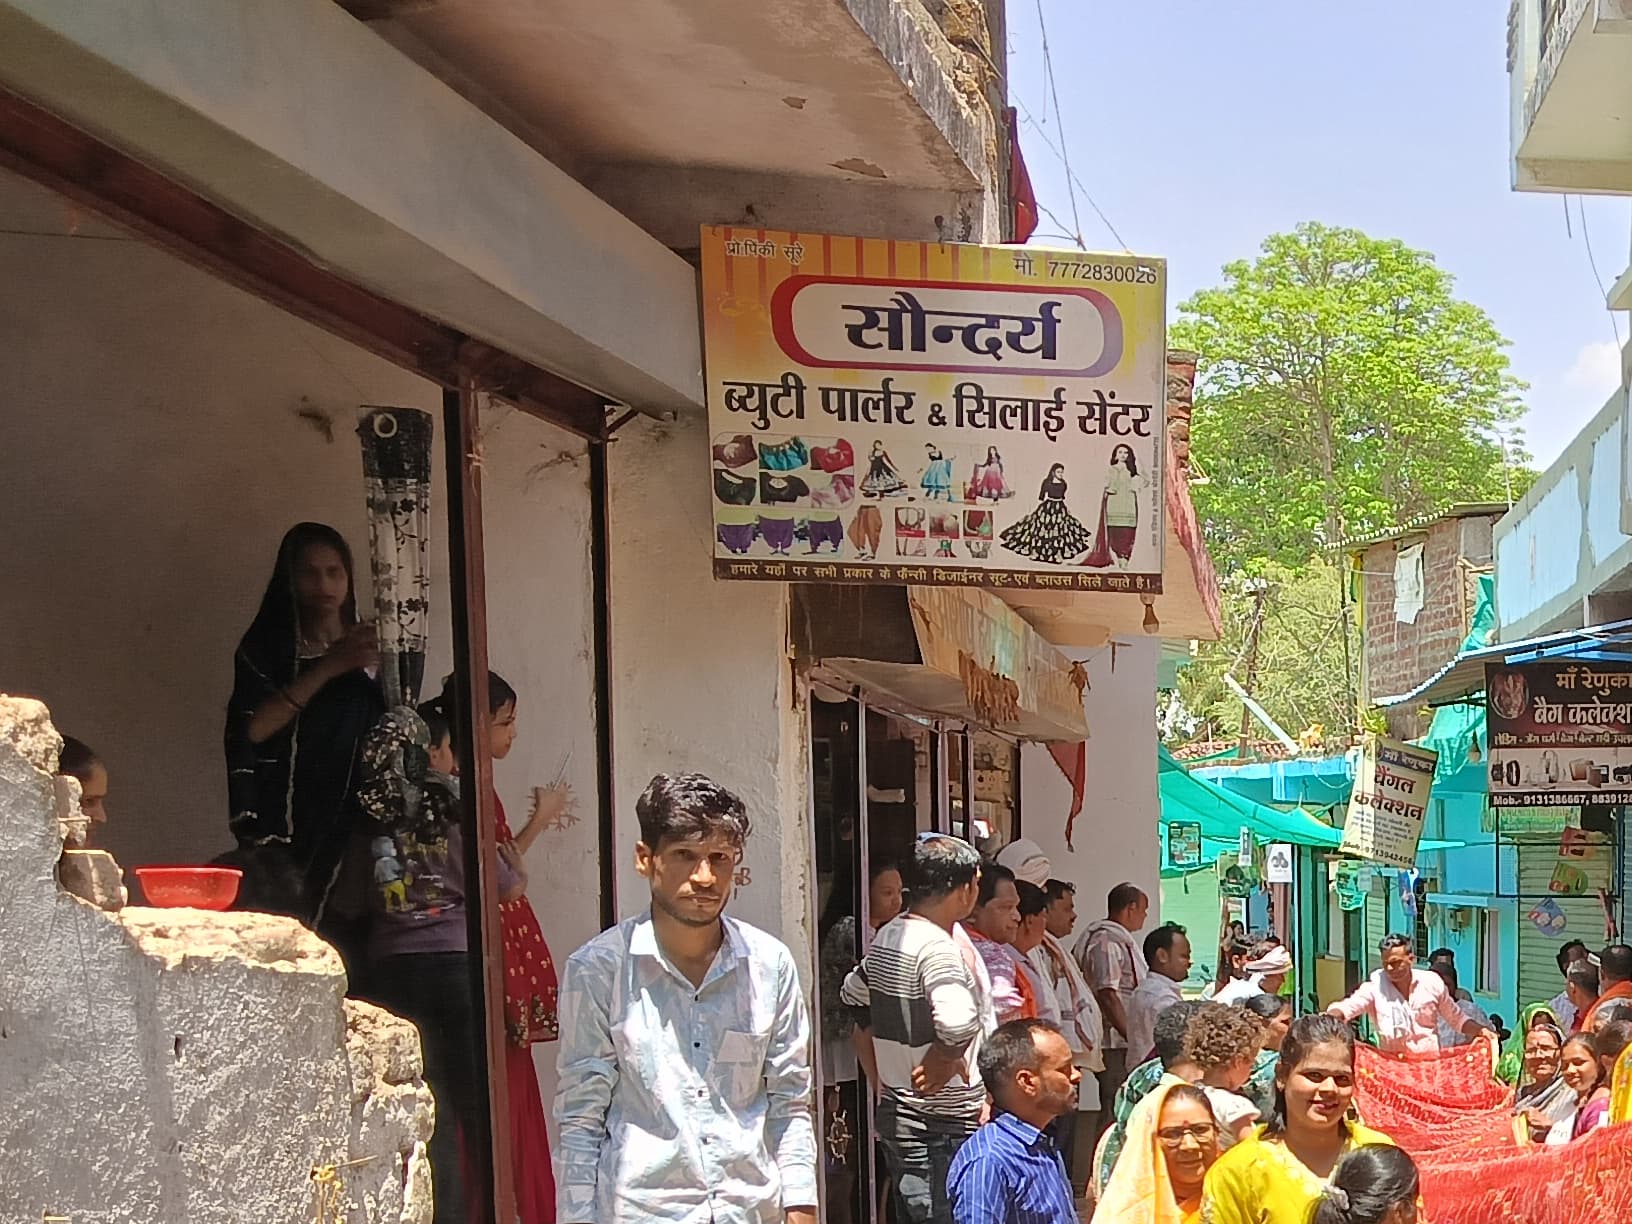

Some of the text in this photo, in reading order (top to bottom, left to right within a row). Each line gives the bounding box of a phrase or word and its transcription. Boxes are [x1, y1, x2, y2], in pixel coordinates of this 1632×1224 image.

[1048, 261, 1157, 285] 7772830026
[841, 291, 1062, 360] सौन्दर्य
[722, 372, 1153, 442] ब्युटी पार्लर & सिलाई सेंटर
[730, 561, 760, 576] हमारे
[792, 566, 808, 577] पर
[813, 564, 836, 578] सभी
[843, 567, 873, 580] प्रकार
[879, 565, 891, 580] के
[1078, 572, 1102, 588] सिले
[1108, 575, 1130, 588] जाते
[1556, 666, 1578, 689] माँ
[1533, 696, 1564, 725] बैग
[1354, 788, 1424, 821] कलेक्शन
